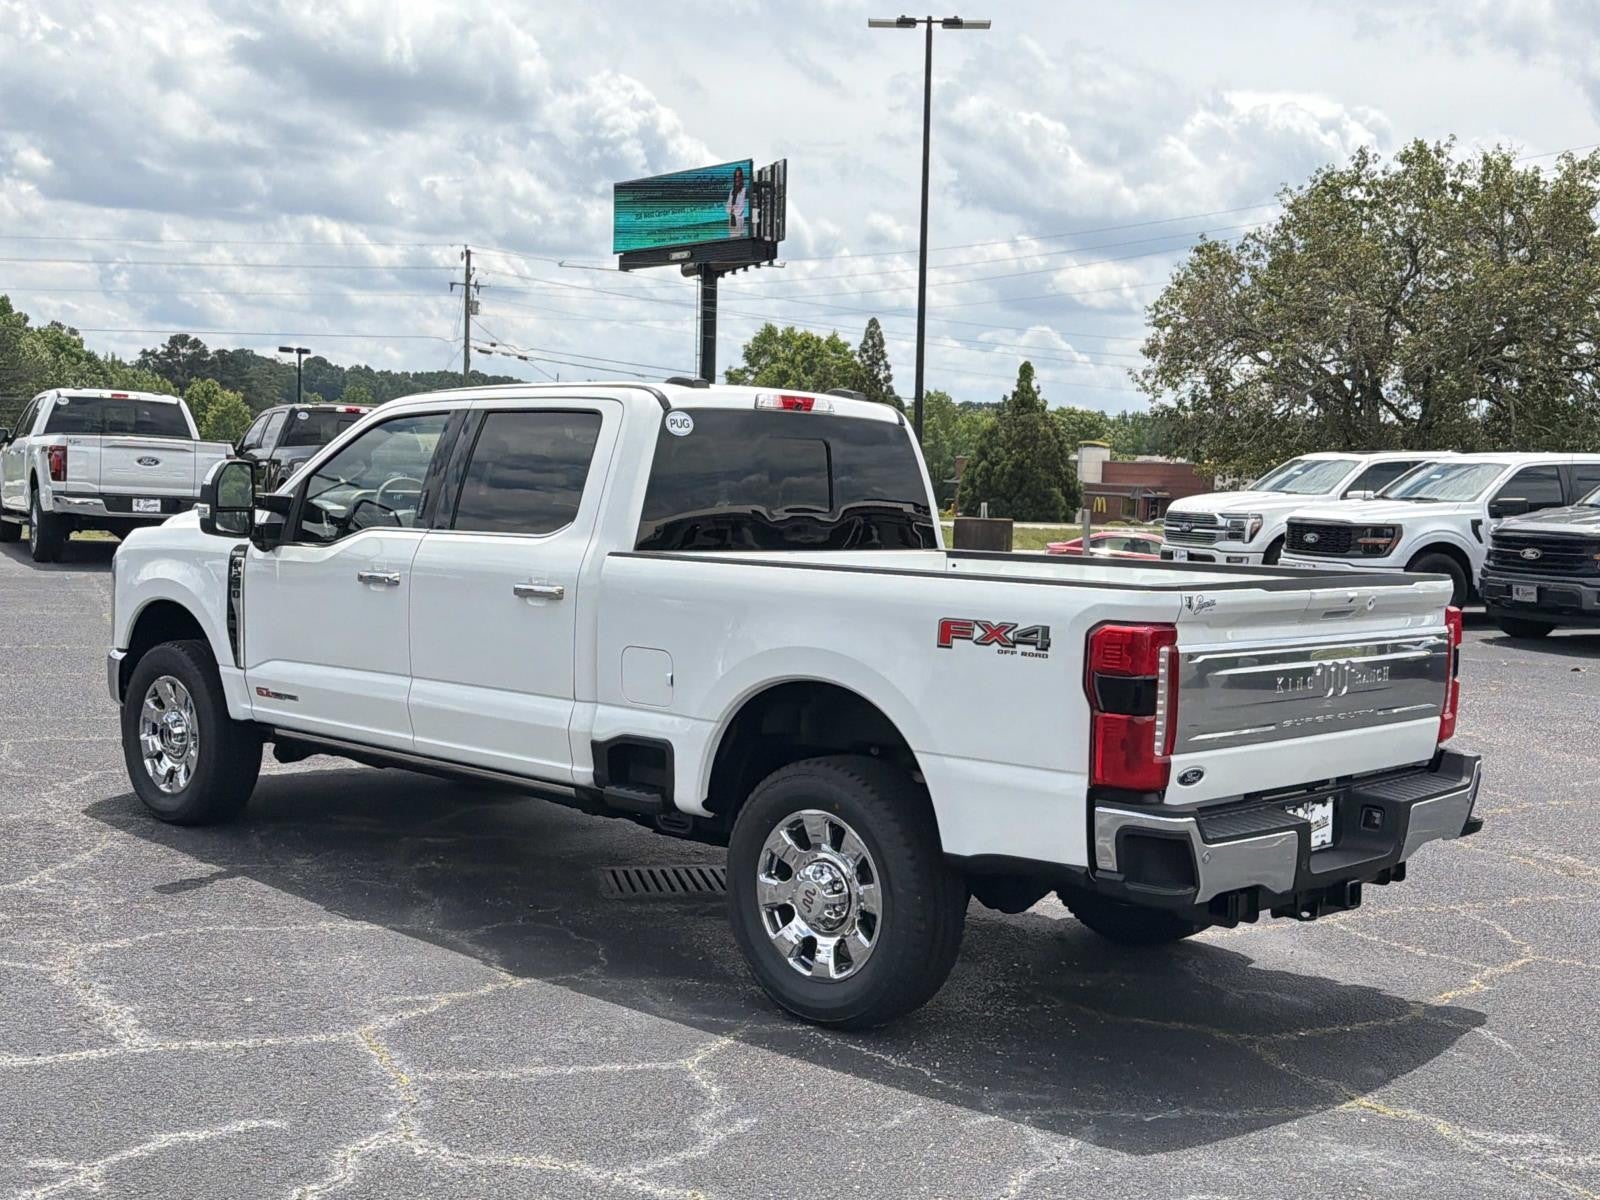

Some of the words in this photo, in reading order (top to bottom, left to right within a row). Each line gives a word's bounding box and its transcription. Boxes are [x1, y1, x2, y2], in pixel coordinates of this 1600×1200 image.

[669, 418, 690, 429] PUG
[937, 617, 1050, 651] FX4
[997, 648, 1018, 656] OFF
[1020, 651, 1049, 659] ROAD
[1274, 676, 1314, 694] KING
